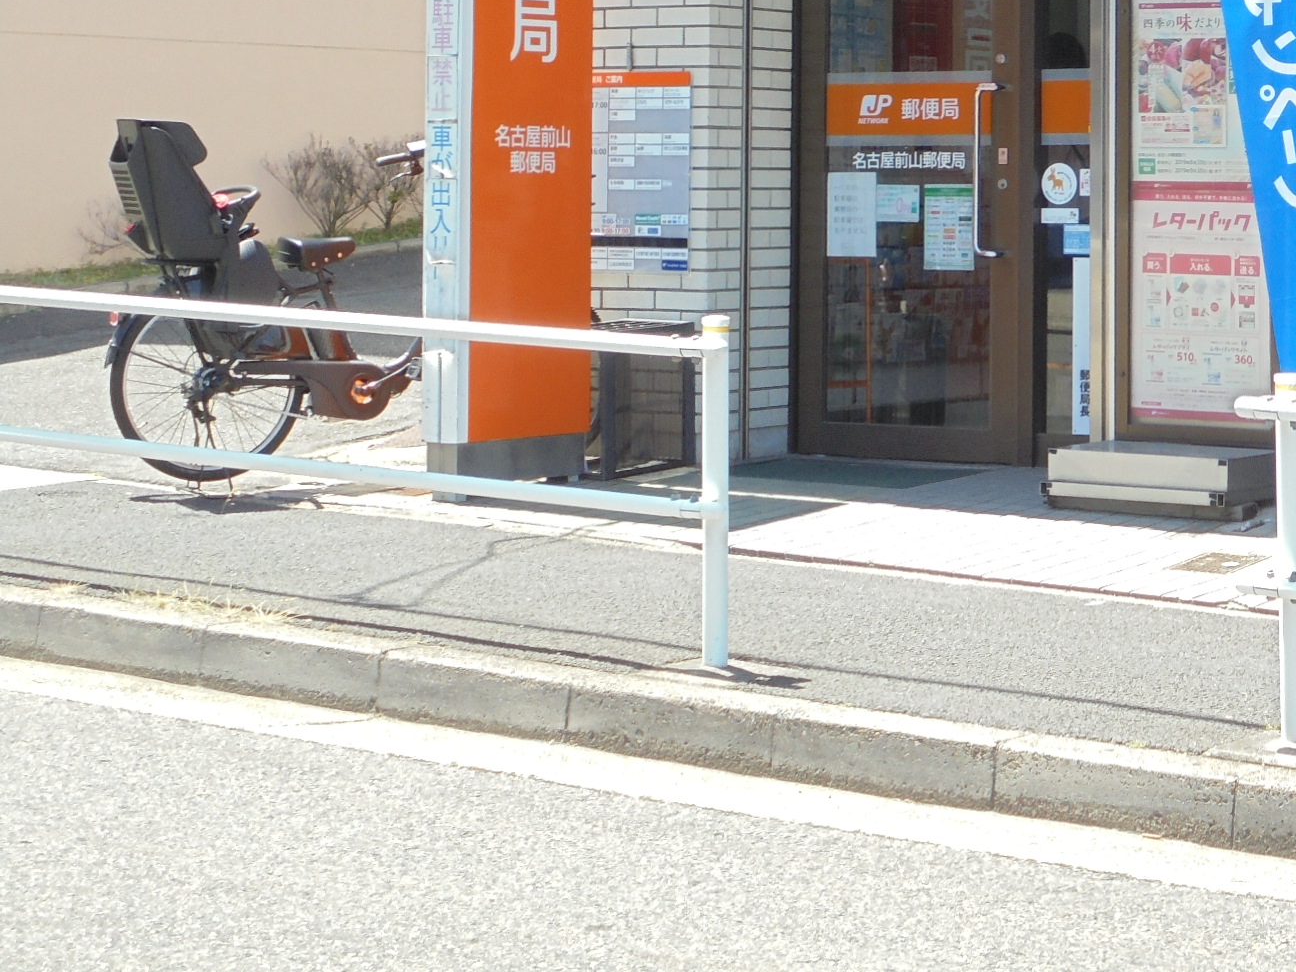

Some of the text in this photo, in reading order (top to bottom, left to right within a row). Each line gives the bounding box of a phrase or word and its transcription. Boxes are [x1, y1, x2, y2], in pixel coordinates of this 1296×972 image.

[1143, 13, 1221, 32] 四季の味だより
[901, 97, 960, 121] 郵便局
[857, 117, 890, 125] NETWORK
[494, 124, 571, 149] 名古屋前山
[509, 150, 556, 175] 郵便局
[852, 151, 966, 170] 名古屋前山郵便局
[1152, 211, 1252, 232] レターパック
